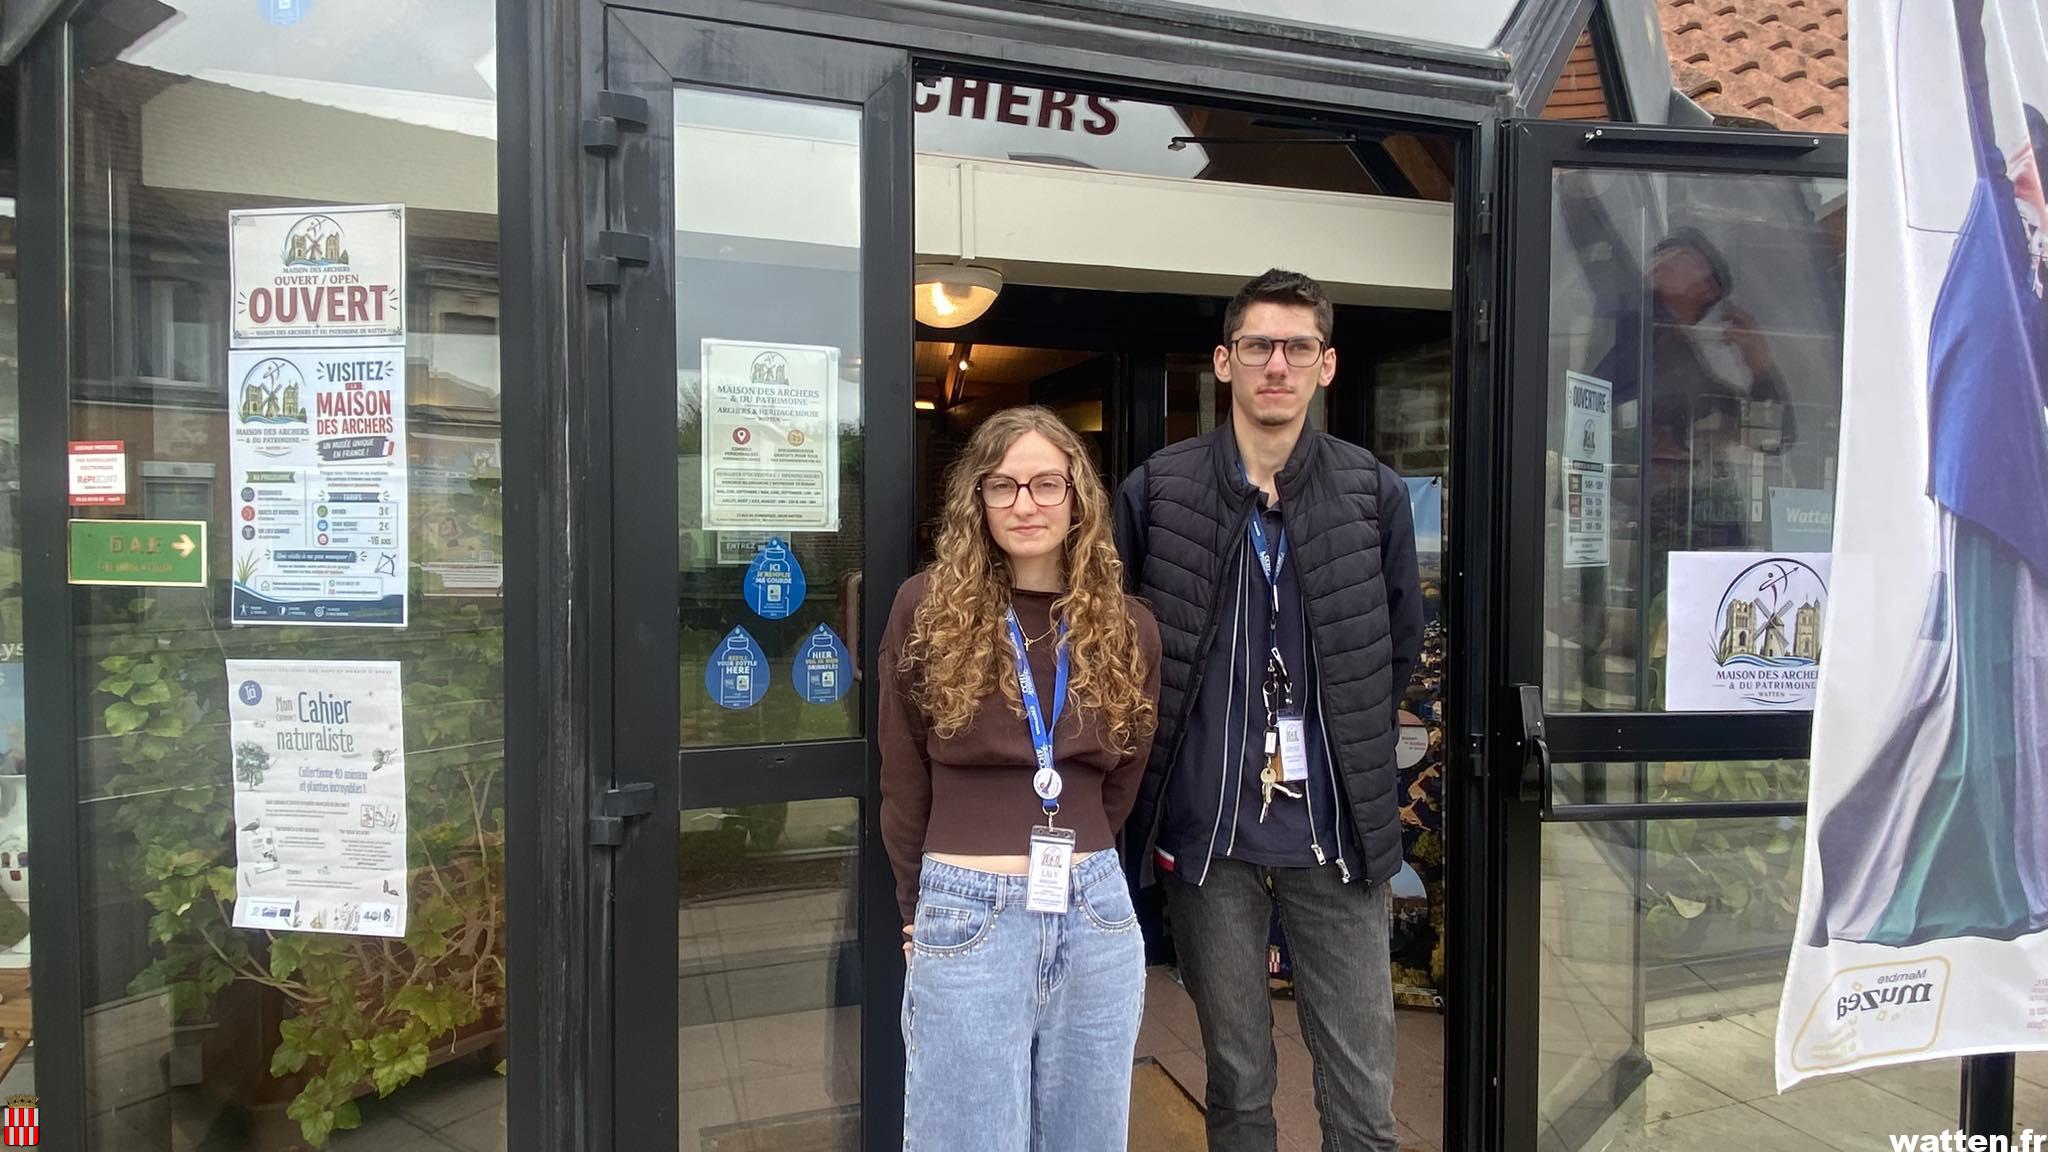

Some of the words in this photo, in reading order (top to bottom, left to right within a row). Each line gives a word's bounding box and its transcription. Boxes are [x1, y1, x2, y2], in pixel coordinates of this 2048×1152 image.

[323, 265, 351, 273] ARCHERS
[274, 275, 319, 286] OUVERT
[329, 274, 360, 285] OPEN
[249, 285, 388, 324] OUVERT
[326, 360, 384, 382] VISITEZ
[717, 385, 755, 395] MAISON
[757, 387, 776, 396] DES
[777, 388, 819, 398] ARCHERS
[316, 390, 391, 418] MAISON
[755, 396, 808, 405] PATRIMOINE
[1573, 385, 1606, 413] OUVERTURE
[317, 418, 338, 435] DES
[341, 416, 393, 435] ARCHERS
[236, 428, 262, 436] MAISON
[263, 428, 277, 436] DES
[322, 442, 332, 450] UN
[352, 438, 375, 447] UNIQUE
[342, 450, 366, 458] FRANCE
[769, 563, 780, 571] ICI
[812, 651, 832, 659] HIER
[726, 666, 750, 674] HERE
[1715, 670, 1757, 680] MAISON
[1758, 671, 1779, 680] DES
[297, 691, 352, 725] Cahier
[276, 726, 354, 753] naturaliste
